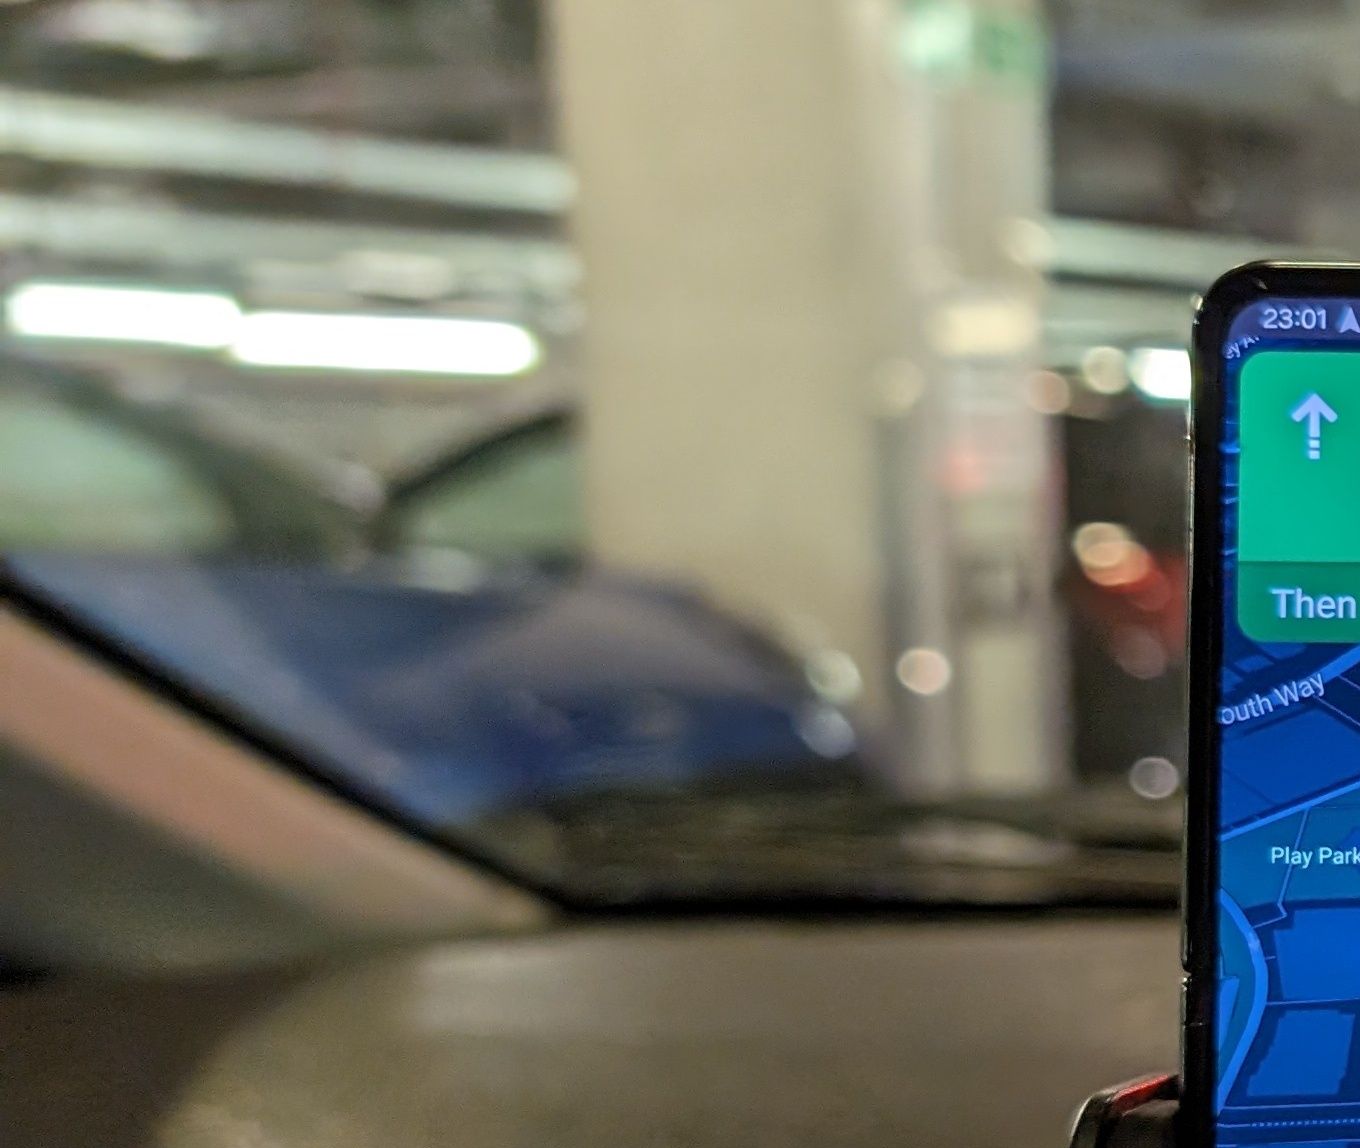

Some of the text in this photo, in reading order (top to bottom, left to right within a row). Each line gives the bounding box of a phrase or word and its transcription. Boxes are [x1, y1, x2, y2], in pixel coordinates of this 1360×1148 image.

[1261, 307, 1328, 331] 23:01
[1270, 588, 1357, 620] Then
[1273, 672, 1325, 707] Way
[1270, 846, 1312, 869] Play
